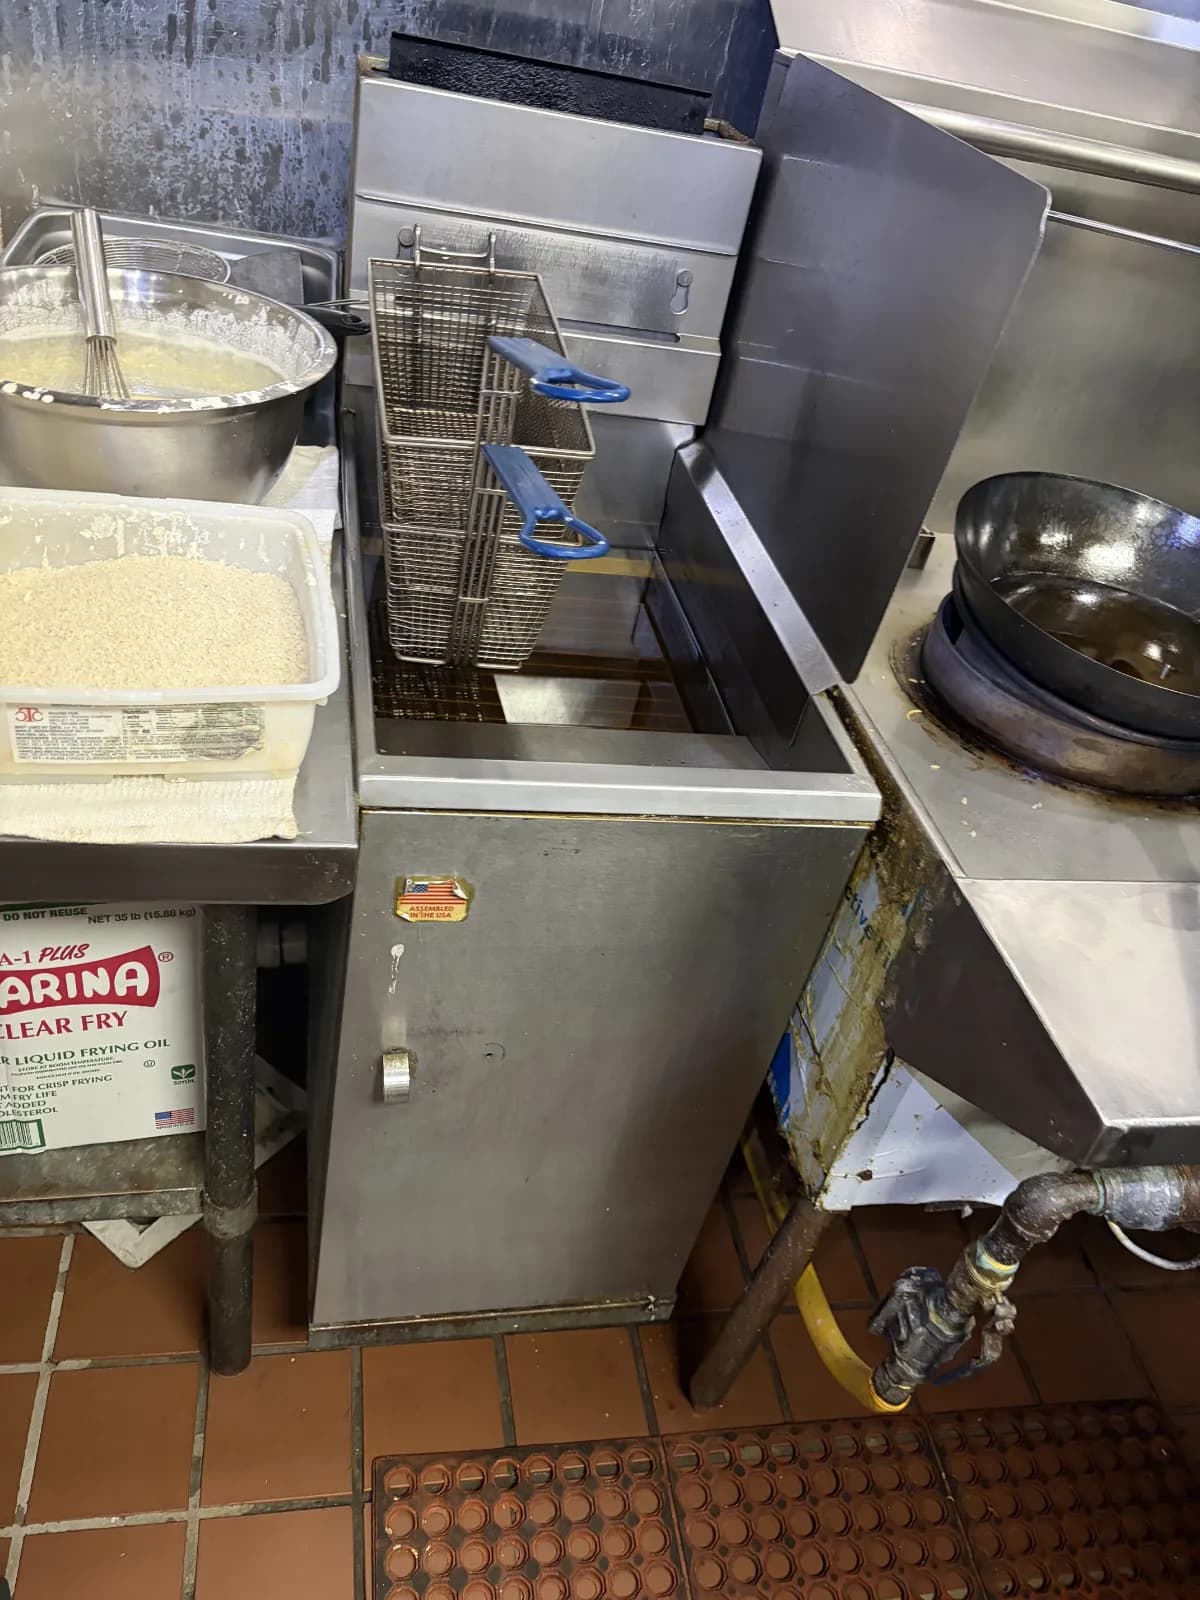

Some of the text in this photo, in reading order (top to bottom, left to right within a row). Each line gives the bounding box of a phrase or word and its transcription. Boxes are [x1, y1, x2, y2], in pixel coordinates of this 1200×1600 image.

[3, 907, 88, 922] DO NOT REUSE
[88, 914, 112, 924] NET
[114, 913, 128, 922] 35
[130, 911, 141, 920] lb
[178, 907, 196, 918] kg)
[0, 943, 90, 967] A-1 PLUS
[0, 1010, 128, 1040] LEAR FRY
[15, 1050, 76, 1066] LIQUID
[80, 1042, 139, 1058] FRYING
[144, 1039, 171, 1049] OIL
[12, 1085, 35, 1093] FOR
[38, 1080, 69, 1090] CRISP
[72, 1074, 113, 1086] FRYING
[5, 1100, 46, 1109] ADDED
[13, 1093, 32, 1101] FRY
[36, 1090, 57, 1098] LIFE
